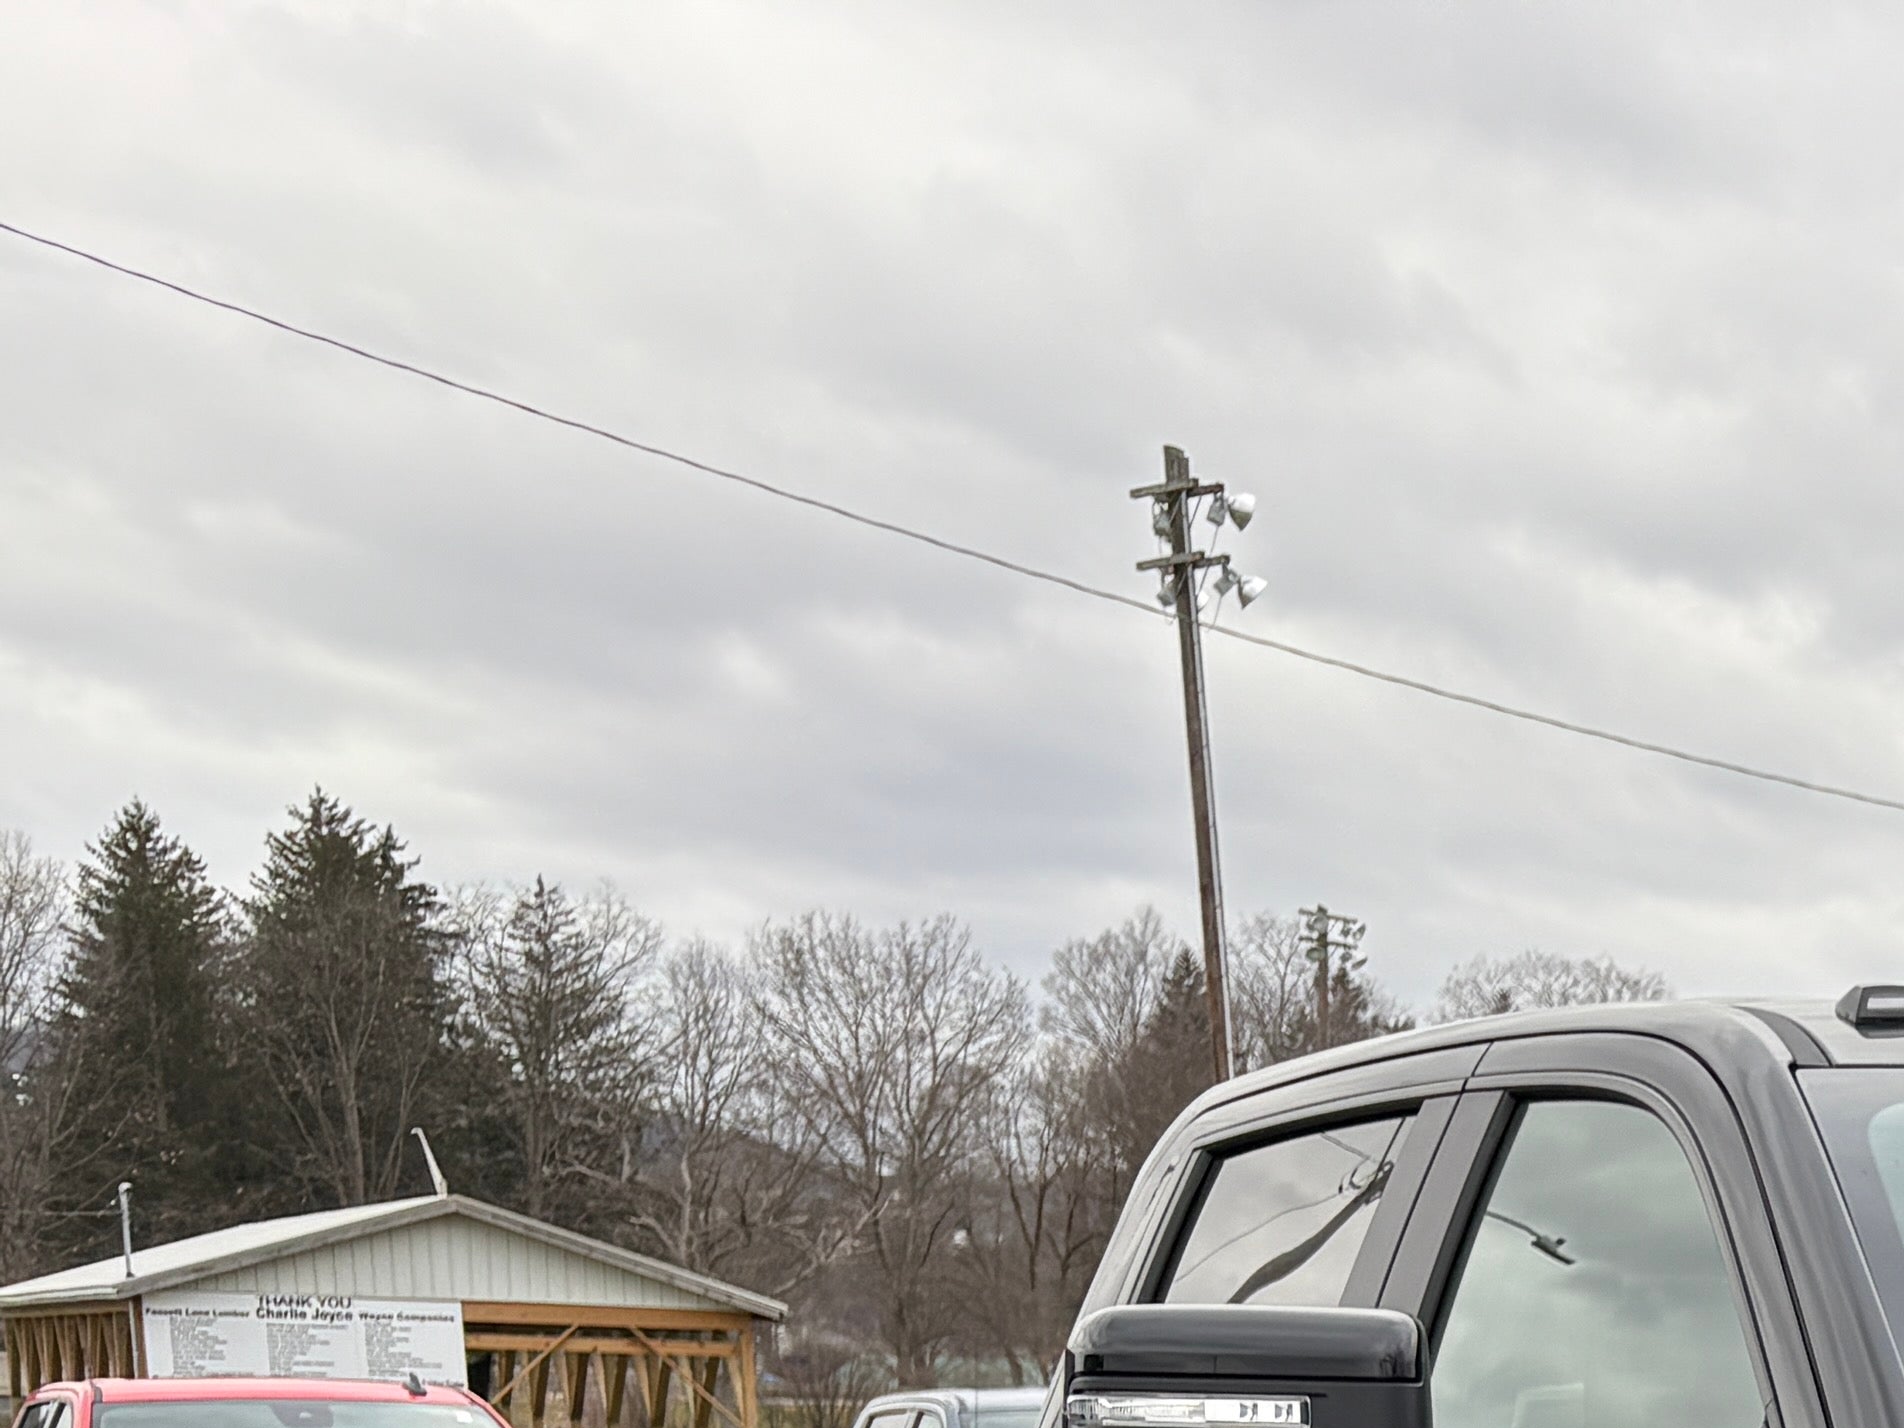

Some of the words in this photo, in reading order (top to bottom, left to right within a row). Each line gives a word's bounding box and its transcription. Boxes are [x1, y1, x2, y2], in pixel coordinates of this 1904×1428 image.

[258, 1295, 312, 1308] THANK
[317, 1296, 352, 1309] YOU
[256, 1307, 308, 1320] Charlie
[311, 1307, 353, 1323] Joyce
